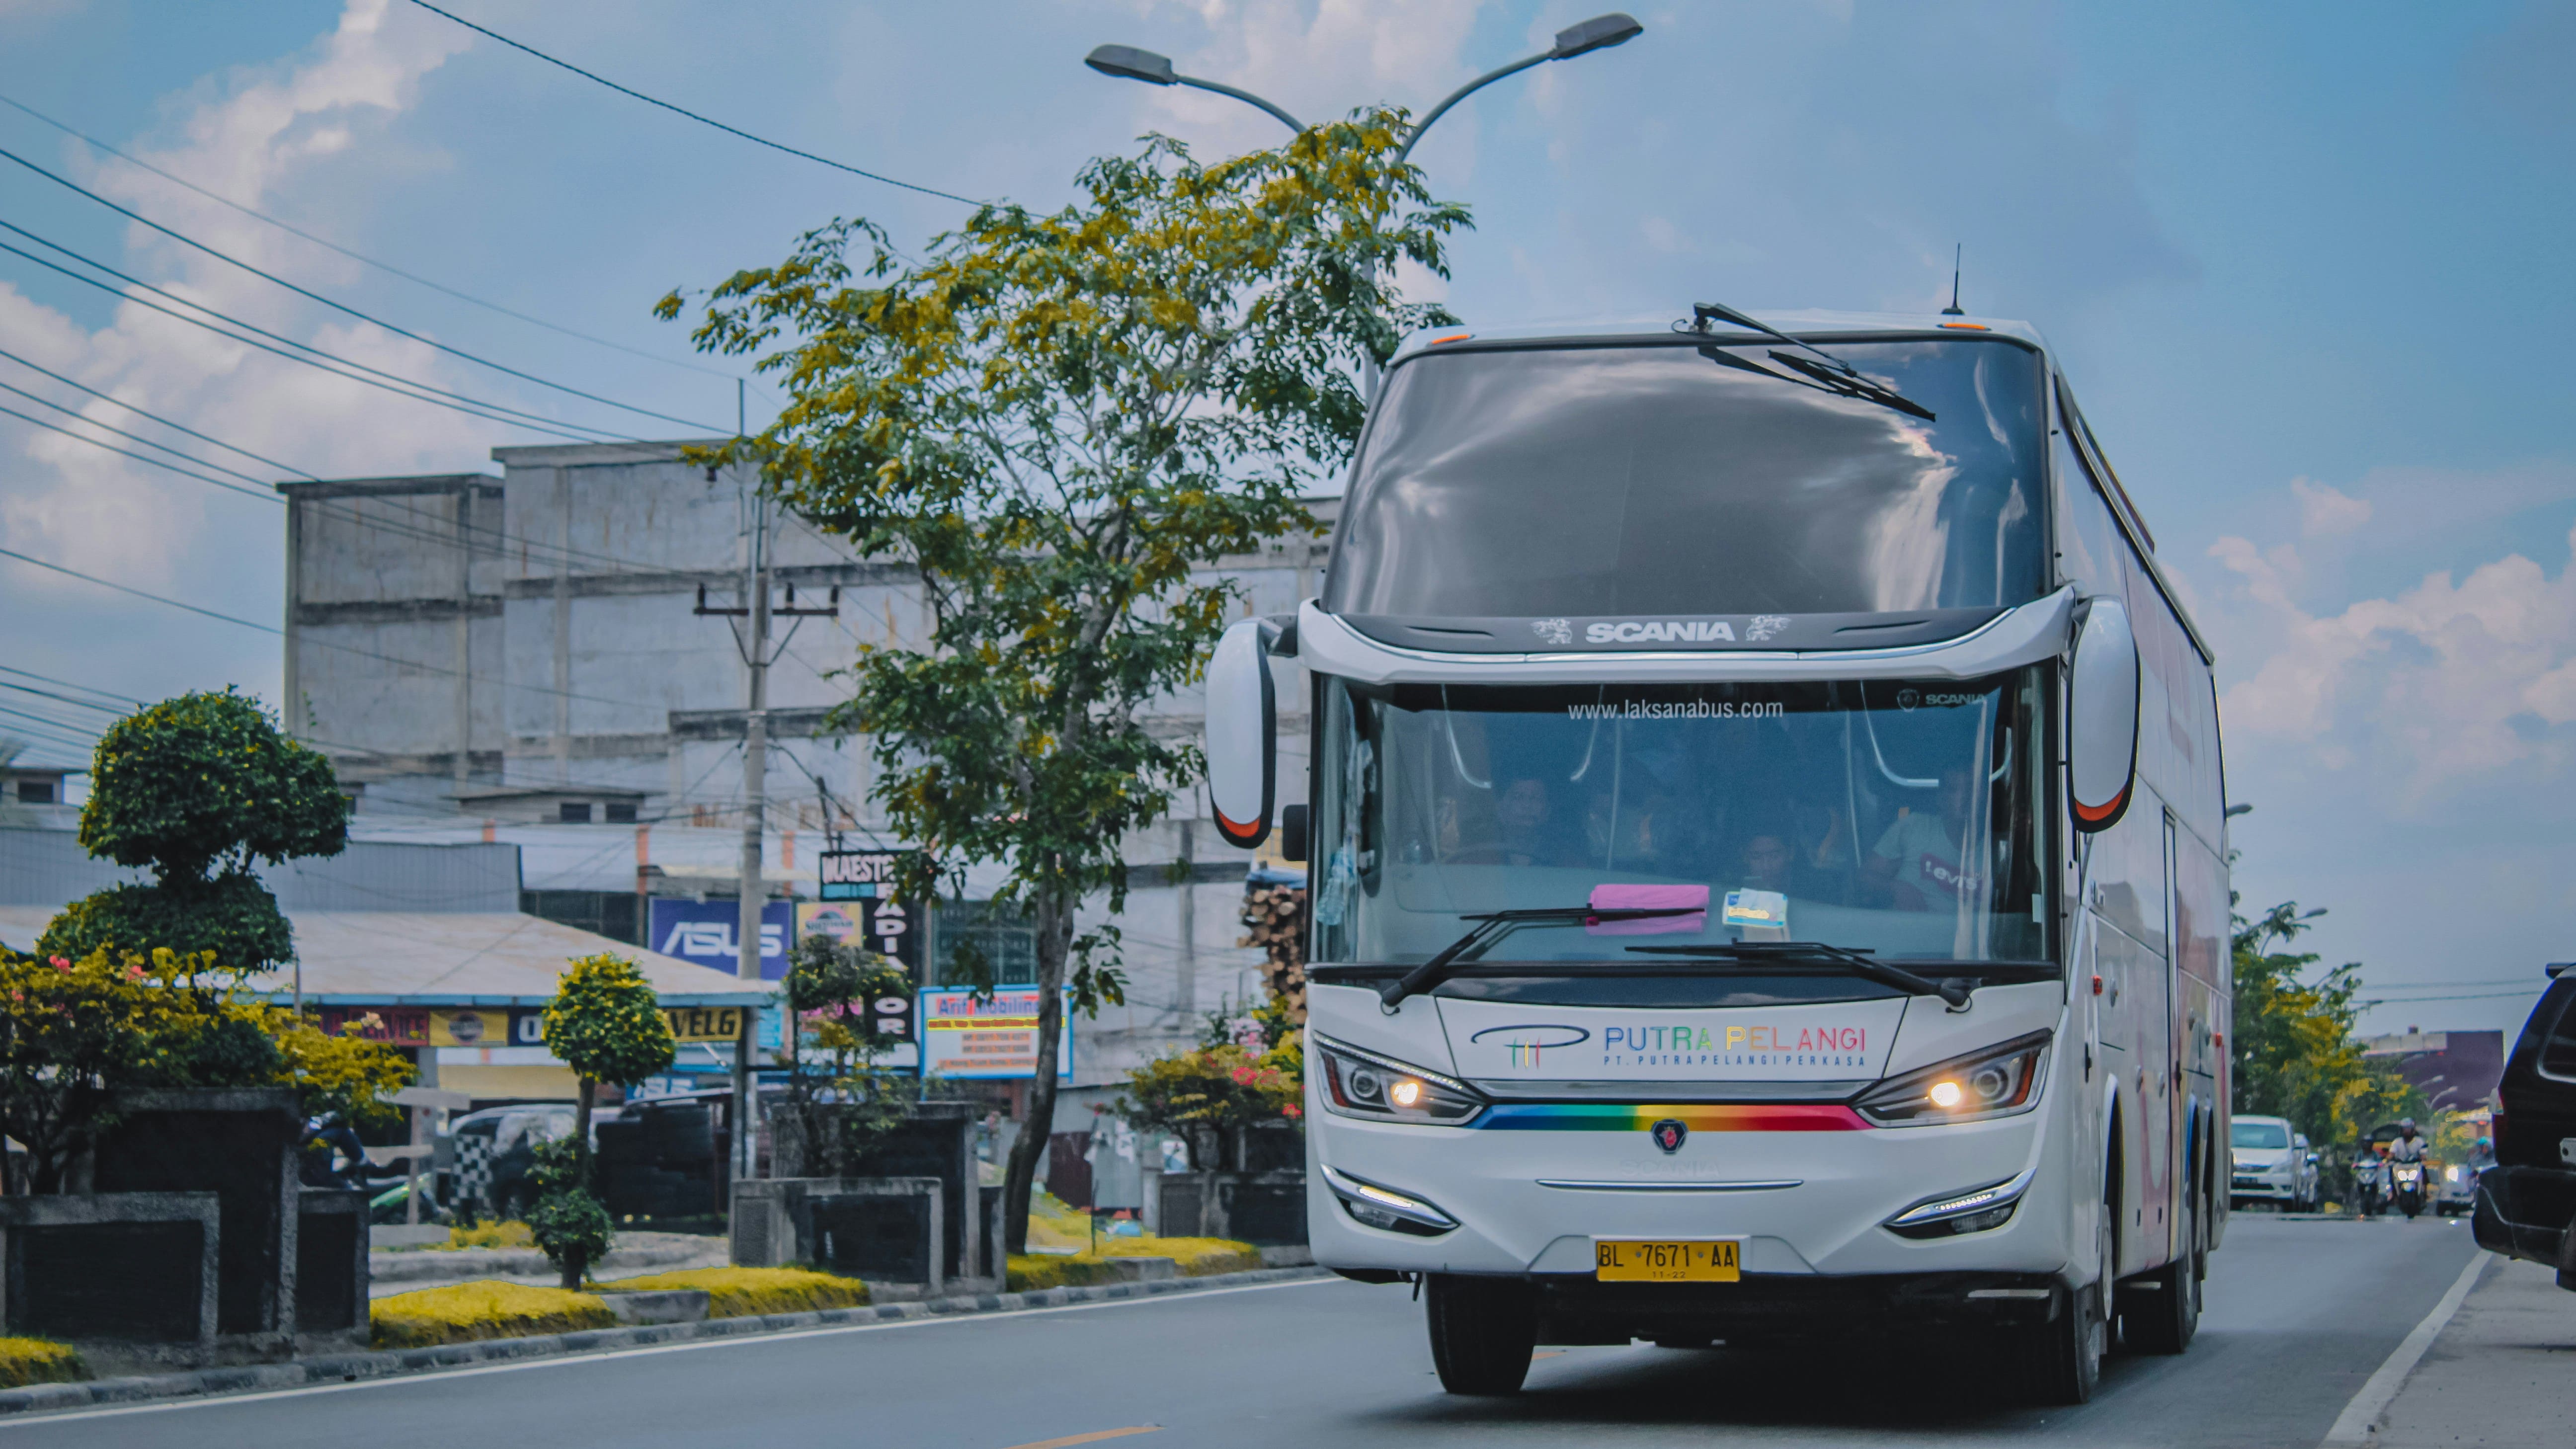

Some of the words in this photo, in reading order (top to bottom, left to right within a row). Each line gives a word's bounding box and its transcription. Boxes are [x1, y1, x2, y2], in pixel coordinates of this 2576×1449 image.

[1585, 622, 1736, 644] SCANIA
[1568, 698, 1783, 720] www.laksanabus.com
[1925, 694, 1987, 705] SCANIA
[671, 1009, 736, 1038] VELG
[1605, 1026, 1713, 1051] PUTRA
[1725, 1026, 1865, 1051] PELANGI
[1604, 1055, 1629, 1066] PT.
[1638, 1054, 1692, 1066] PUTRA
[1701, 1054, 1777, 1066] PELANGI
[1785, 1055, 1864, 1067] PERKASA
[1620, 1159, 1721, 1177] SCANIA
[1599, 1244, 1624, 1267] BL
[1642, 1244, 1690, 1267] 7671
[1711, 1244, 1734, 1267] AA
[1652, 1271, 1687, 1279] 11-22
